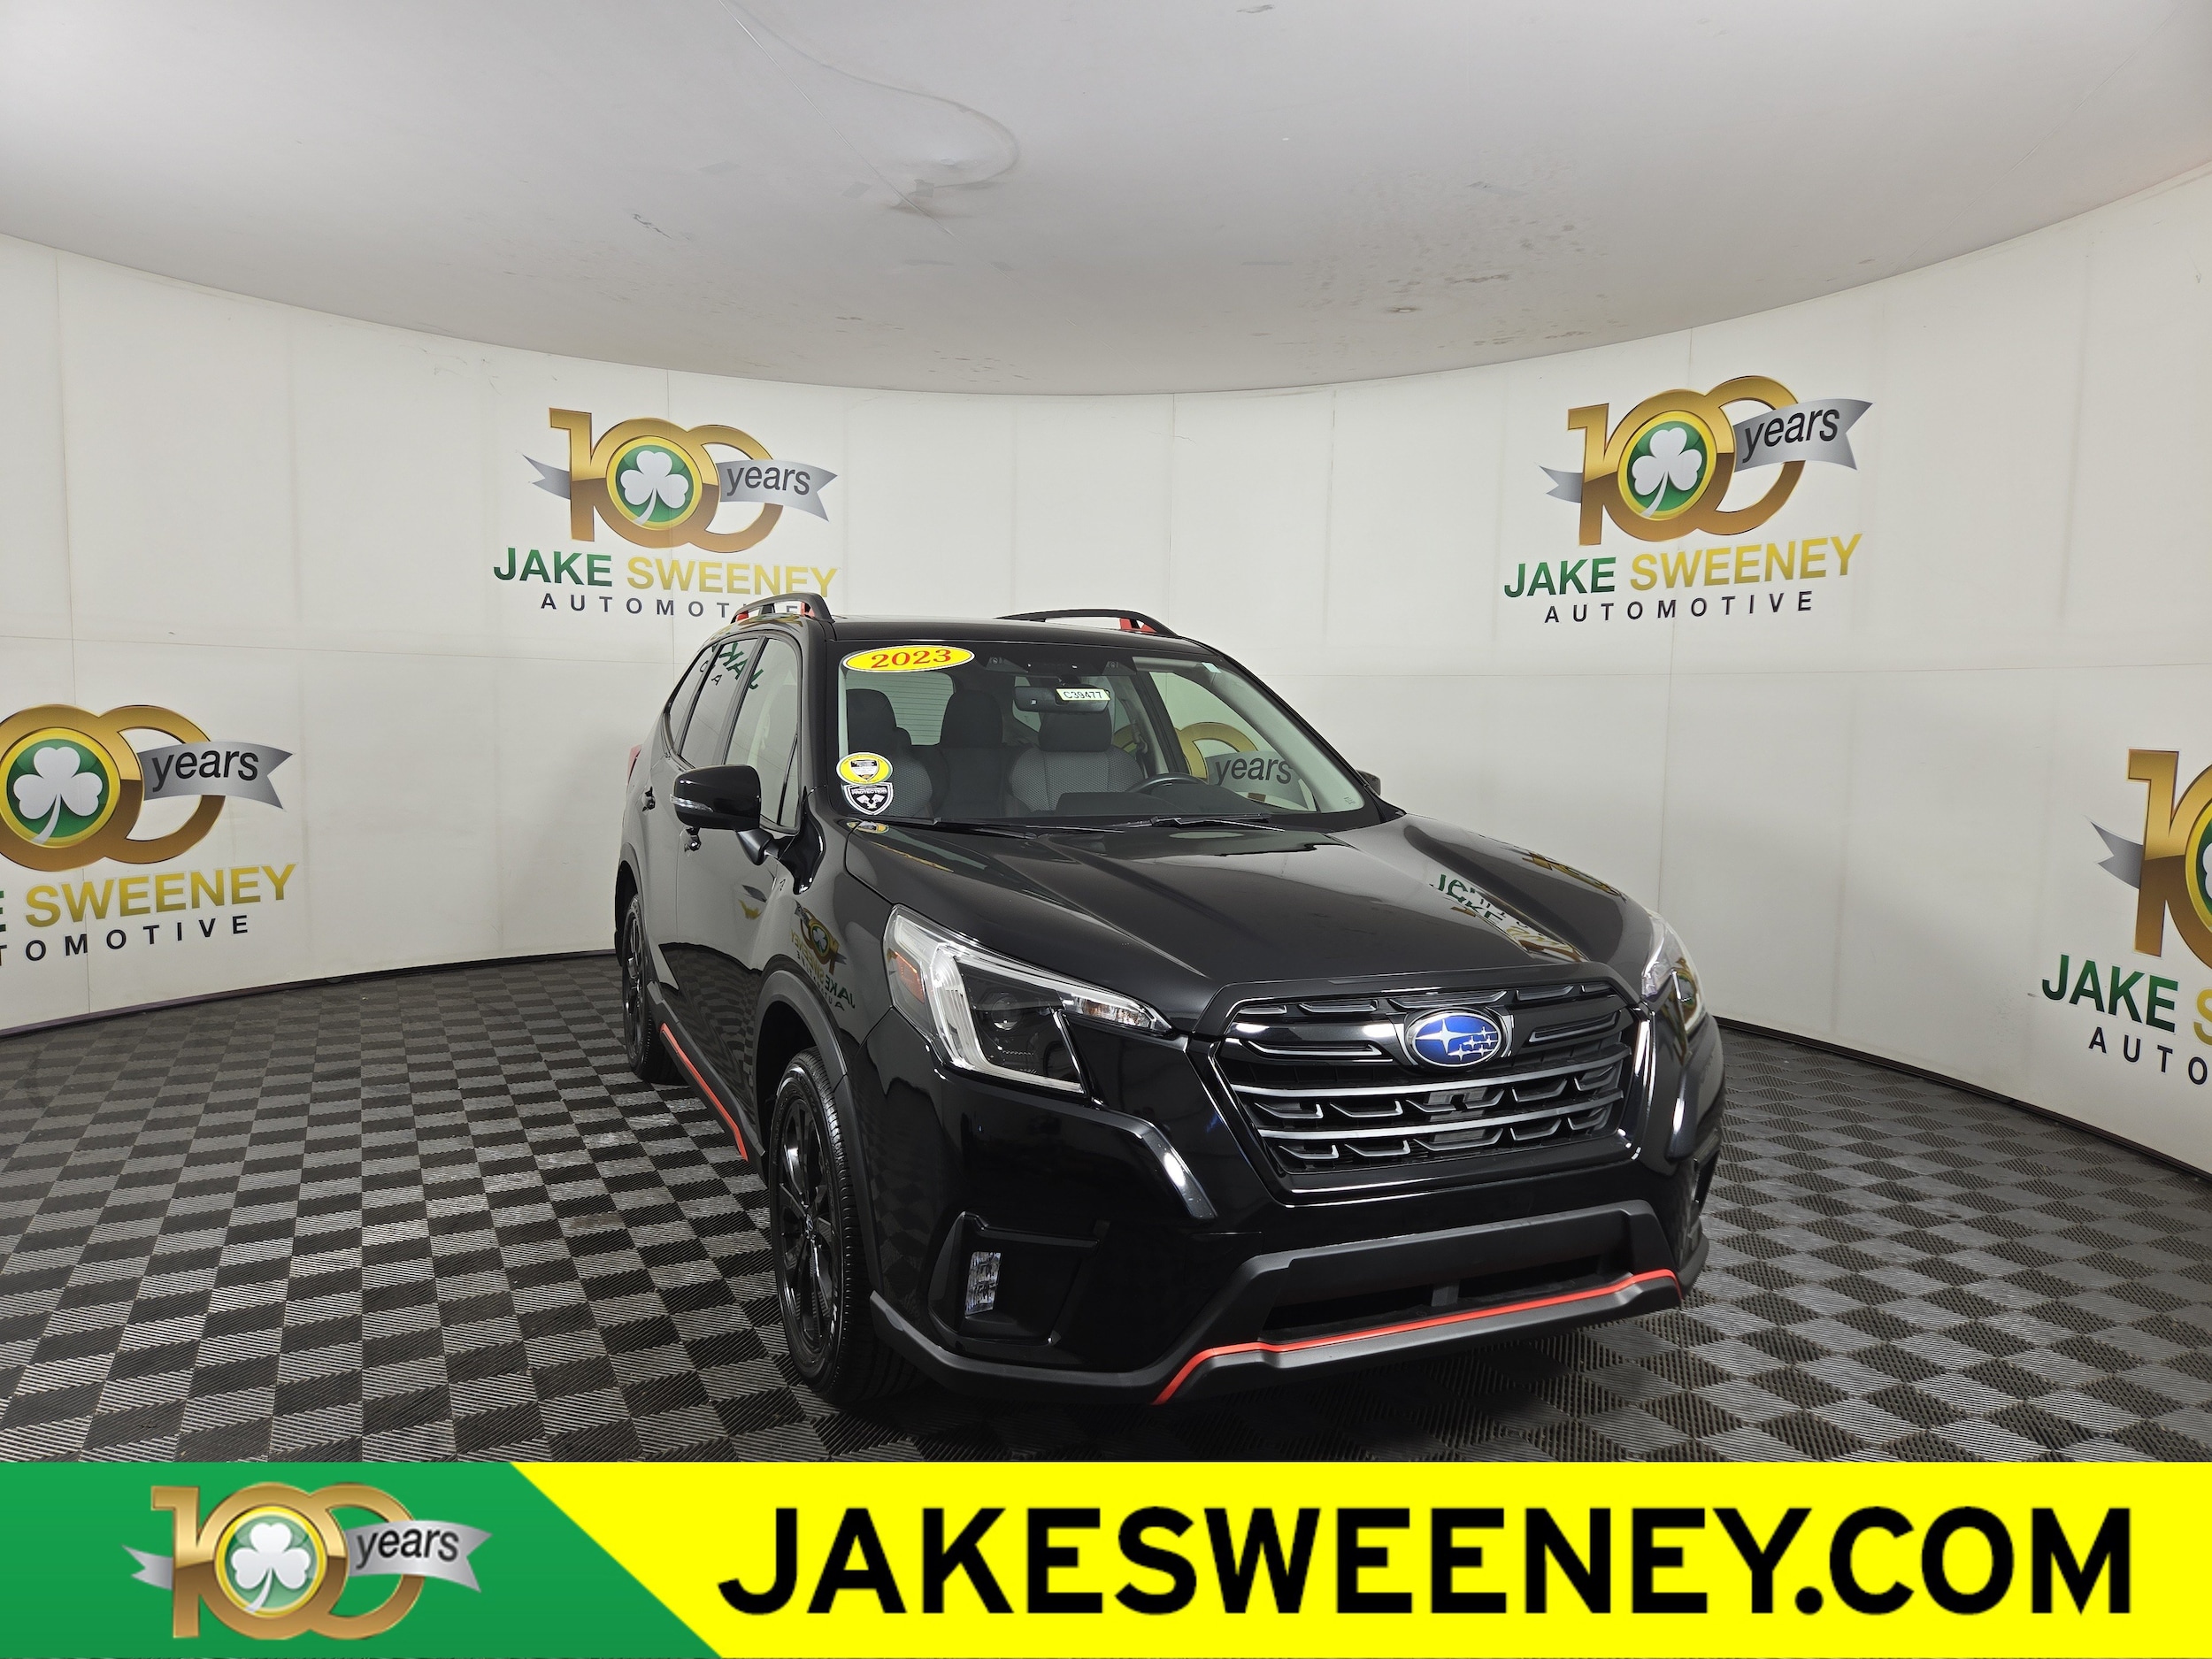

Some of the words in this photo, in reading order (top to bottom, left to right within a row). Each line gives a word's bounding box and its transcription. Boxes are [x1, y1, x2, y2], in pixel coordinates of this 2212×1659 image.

[549, 407, 785, 554] 100
[726, 464, 811, 496] years
[1567, 375, 1806, 547] 100
[1742, 404, 1840, 464] years
[493, 547, 613, 588] JAKE
[626, 556, 838, 598] SWEENEY
[1504, 556, 1617, 599] JAKE
[1630, 533, 1863, 592] SWEENEY
[1544, 590, 1813, 624] AUTOMOTIVE
[871, 649, 951, 670] 2023
[152, 749, 259, 793] years
[1215, 757, 1293, 787] years
[25, 863, 297, 928] SWEENEY
[2041, 954, 2179, 1033] JAKE
